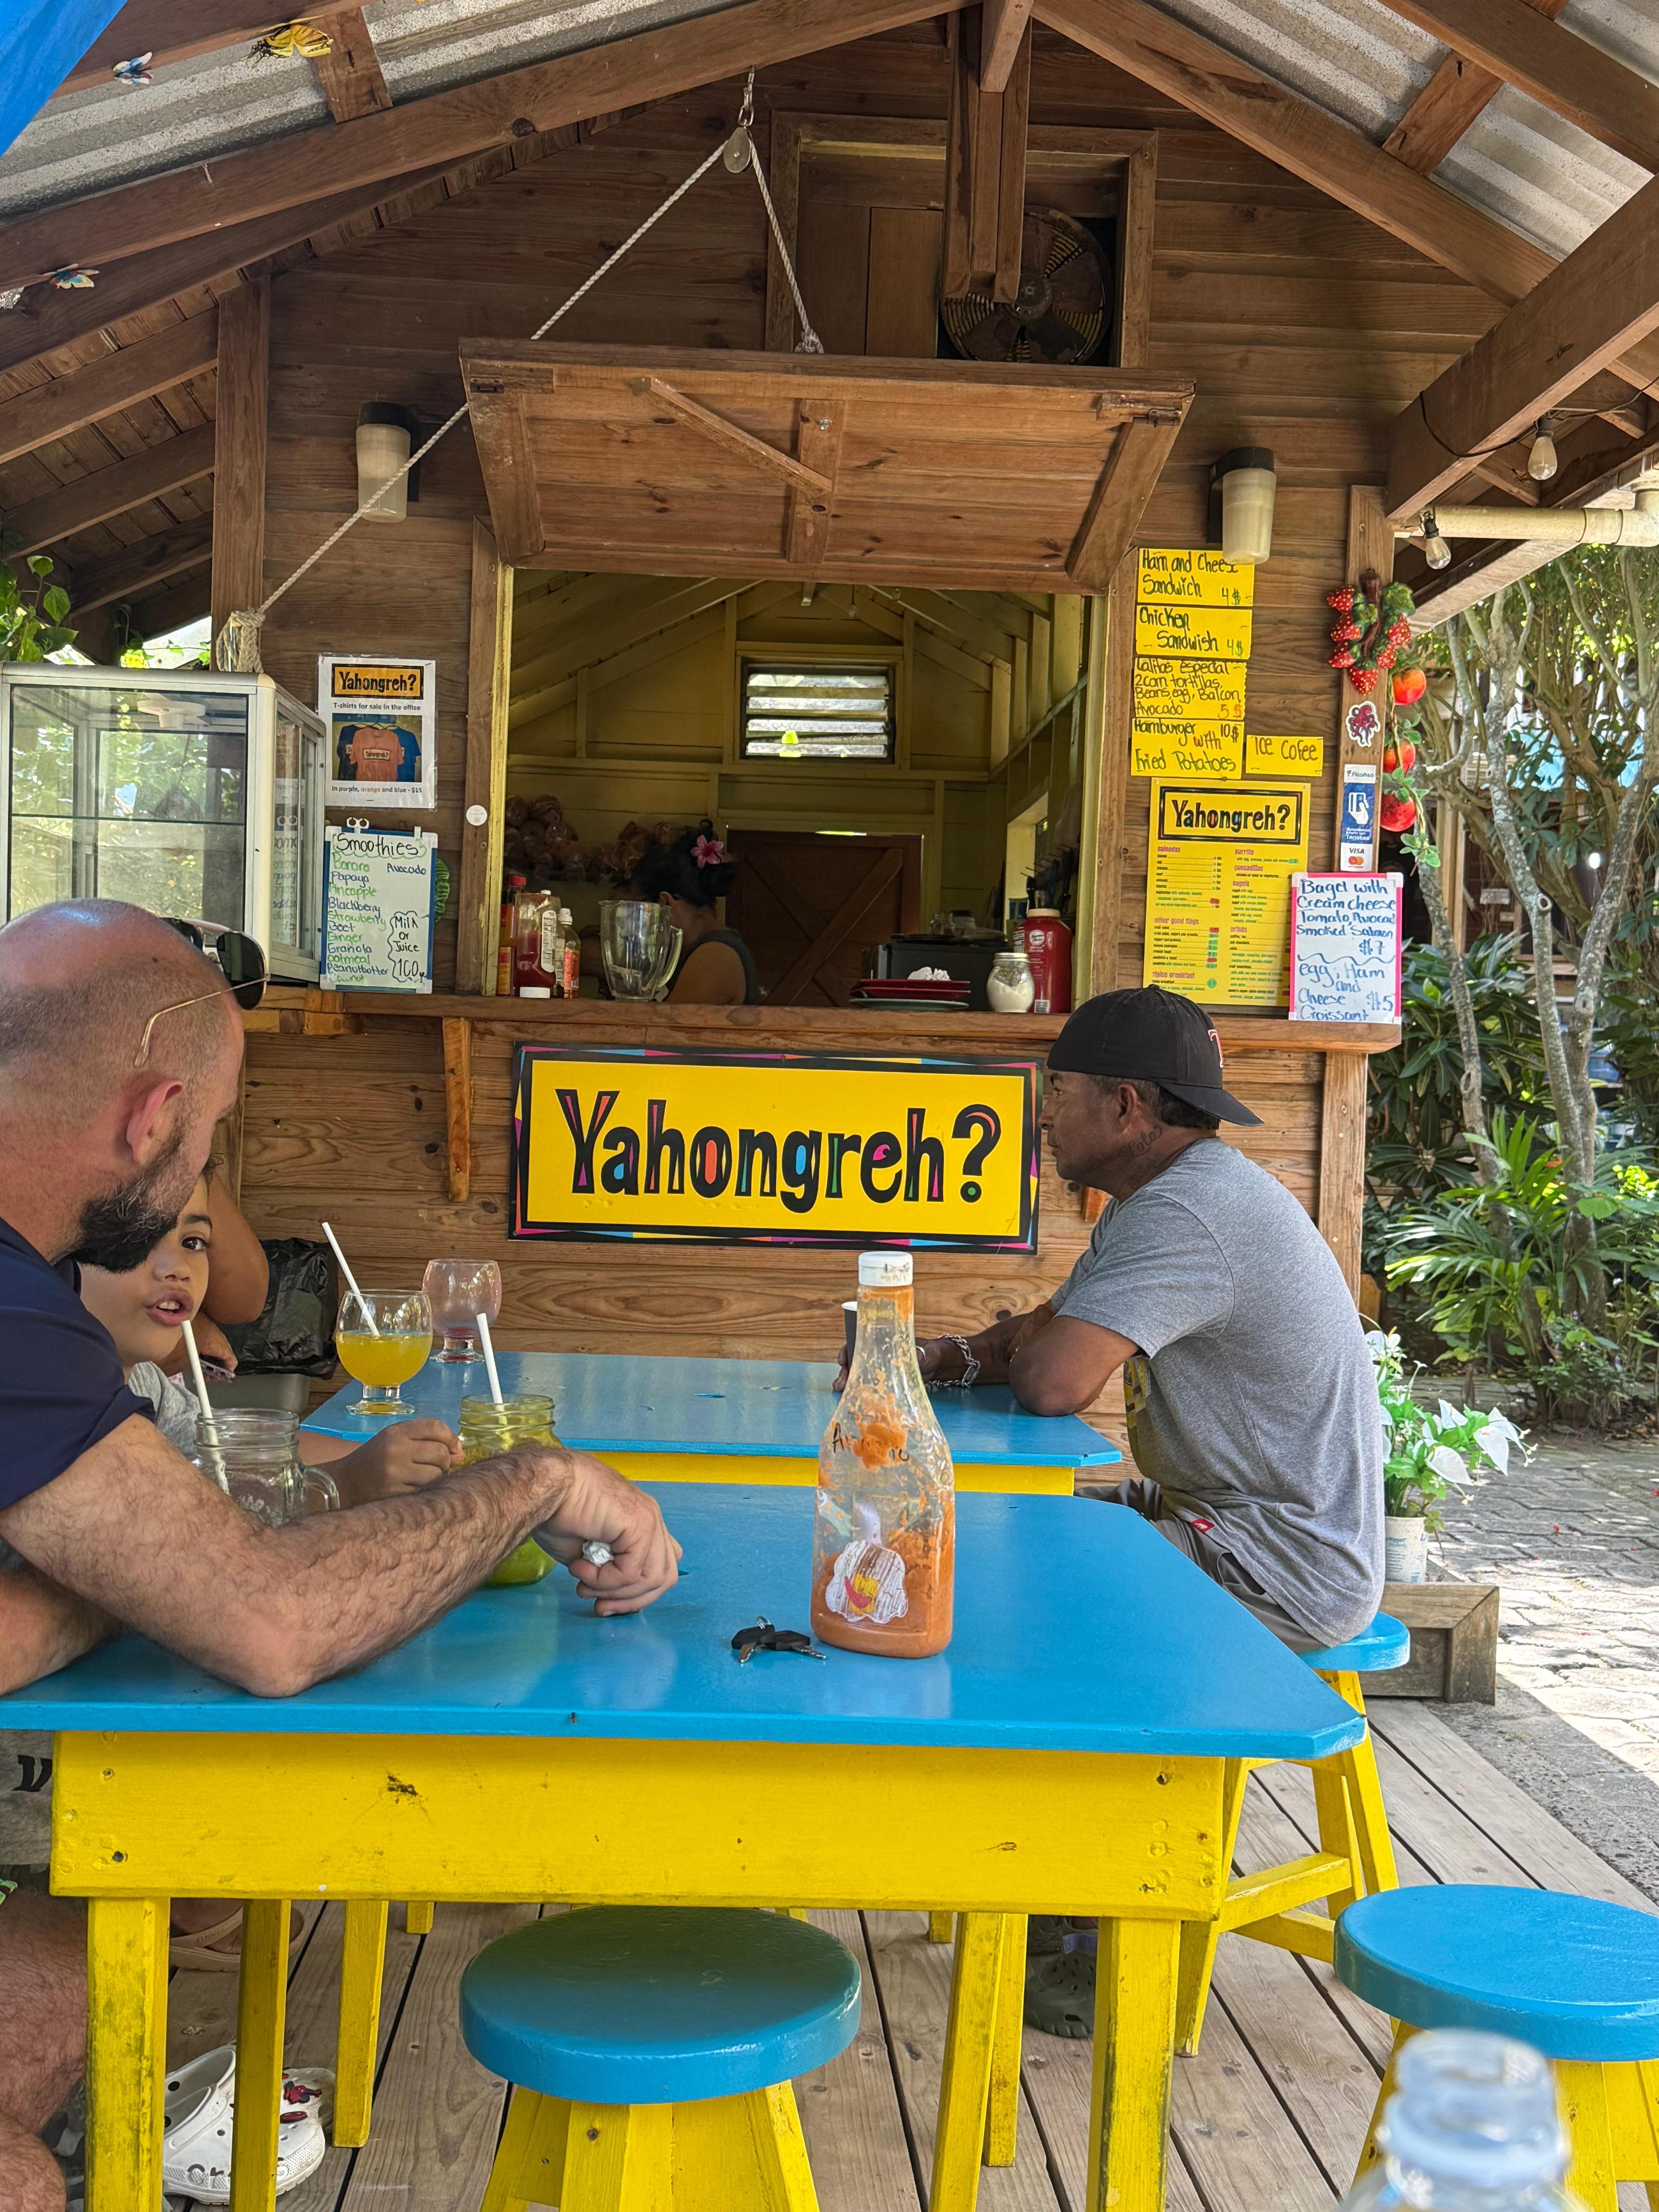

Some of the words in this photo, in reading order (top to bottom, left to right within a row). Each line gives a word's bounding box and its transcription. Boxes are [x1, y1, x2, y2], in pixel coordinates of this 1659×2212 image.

[1143, 550, 1168, 572] Ham
[1171, 551, 1192, 572] and
[1143, 572, 1202, 597] Sandwich
[1140, 606, 1190, 631] Chicken
[1157, 630, 1219, 652] Sandwish
[338, 671, 417, 693] Yahongreh?
[1136, 700, 1183, 715] Avocado
[1134, 718, 1196, 747] Hamburger
[1194, 731, 1222, 750] with
[1135, 748, 1166, 770] Fried
[1171, 750, 1236, 772] Potatoes
[1171, 799, 1291, 833] Yahongreh?
[337, 833, 419, 857] Smoothies
[332, 852, 370, 872] Banana
[387, 863, 426, 874] Avocado
[331, 871, 369, 888] Papaya
[1301, 879, 1348, 900] Bagel
[1354, 879, 1388, 894] with
[329, 882, 377, 900] Pineapple
[329, 897, 381, 919] Blackberry
[1297, 896, 1345, 910] Cream
[328, 921, 356, 932] Beet
[395, 916, 418, 928] Milk
[1296, 924, 1346, 936] Smoked
[328, 931, 362, 945] Ginger
[328, 943, 372, 953] Granola
[393, 941, 419, 952] Juice
[1344, 963, 1385, 979] Ham
[1335, 980, 1361, 993] and
[1298, 988, 1346, 1005] Cheese
[1366, 991, 1394, 1011] $5
[1300, 1005, 1369, 1021] Croissant
[555, 1088, 1001, 1213] Yahongreh?
